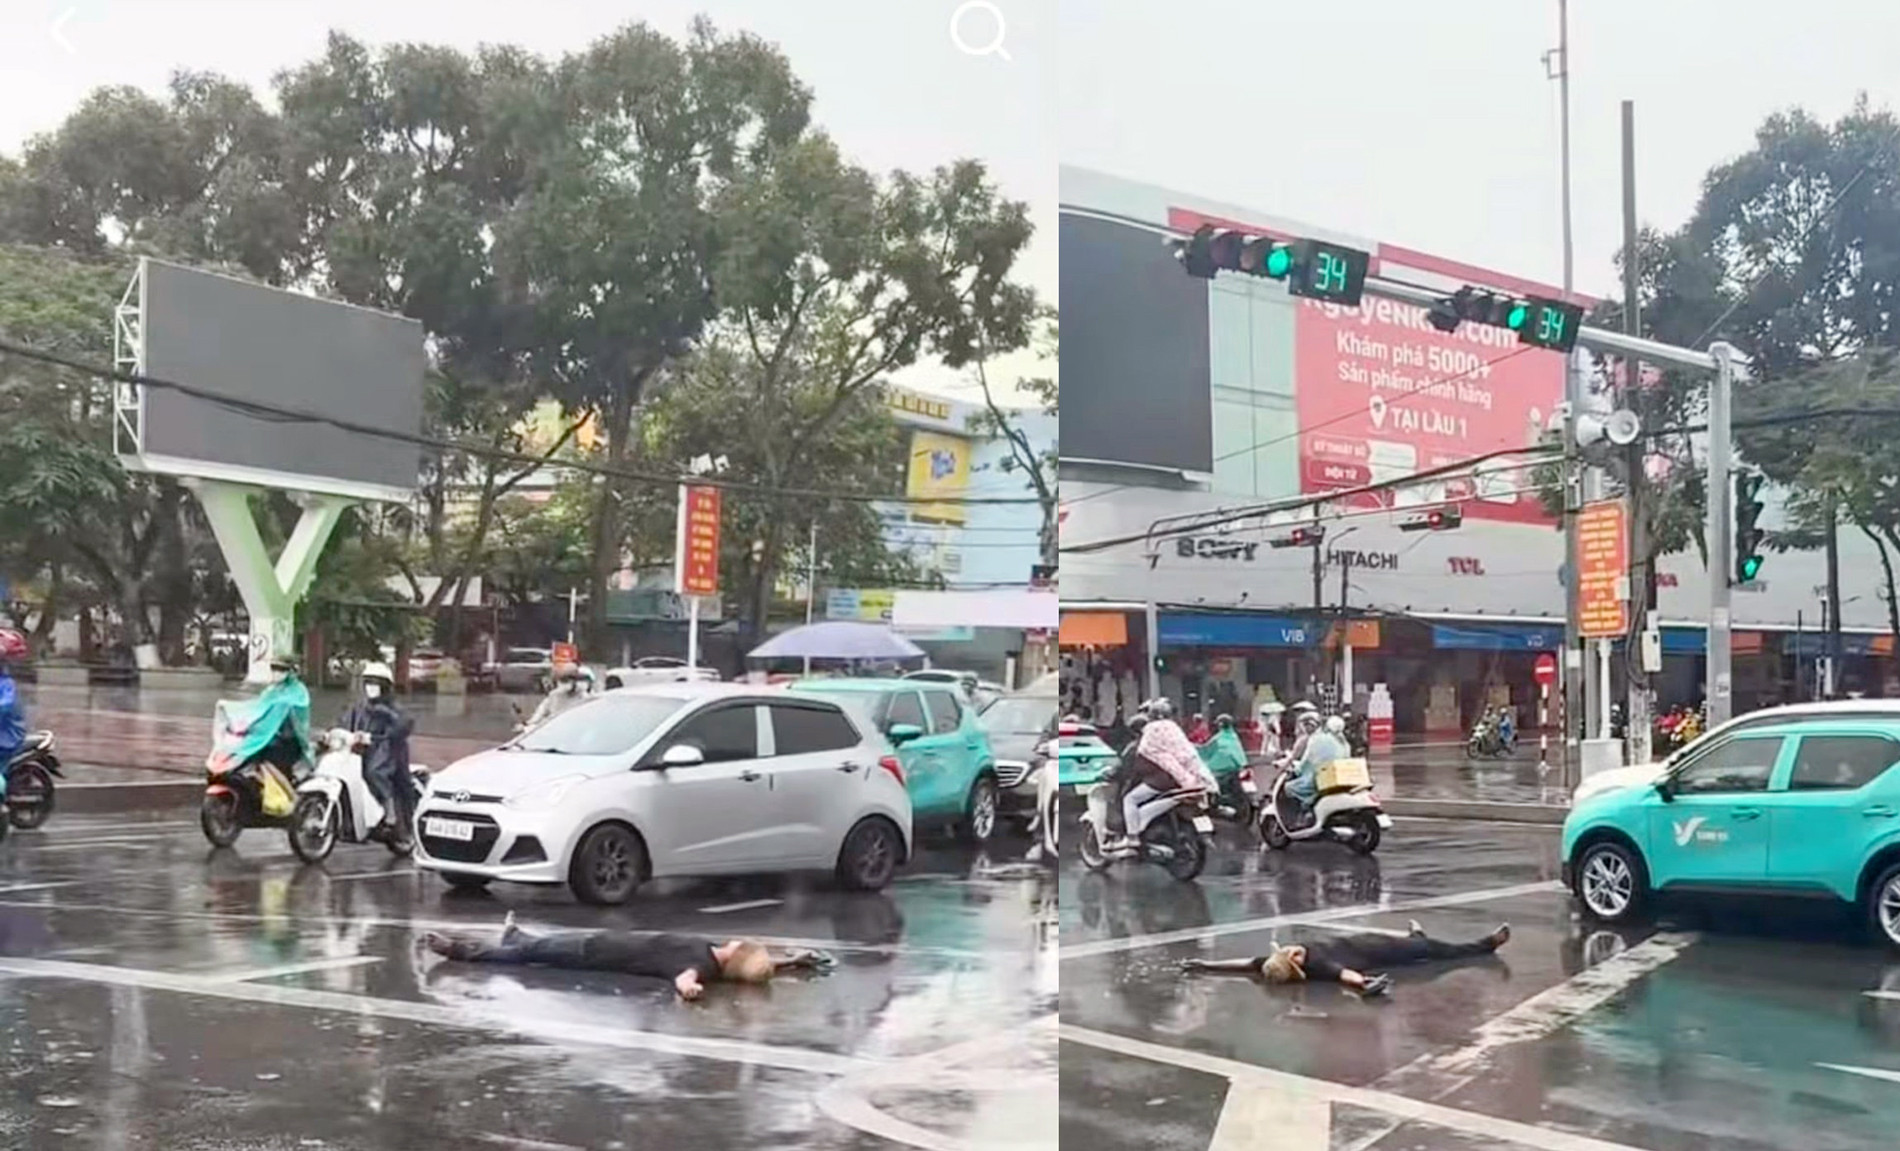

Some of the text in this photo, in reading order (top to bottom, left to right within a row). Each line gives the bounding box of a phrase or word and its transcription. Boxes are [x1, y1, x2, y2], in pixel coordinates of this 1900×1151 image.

[1314, 252, 1347, 292] 34
[1539, 306, 1564, 342] 34
[1337, 330, 1491, 379] Khám phá 5000+
[1391, 407, 1418, 433] TẠI
[1326, 550, 1398, 570] HITACHI
[1447, 556, 1486, 576] TCL
[1280, 628, 1305, 643] VIB
